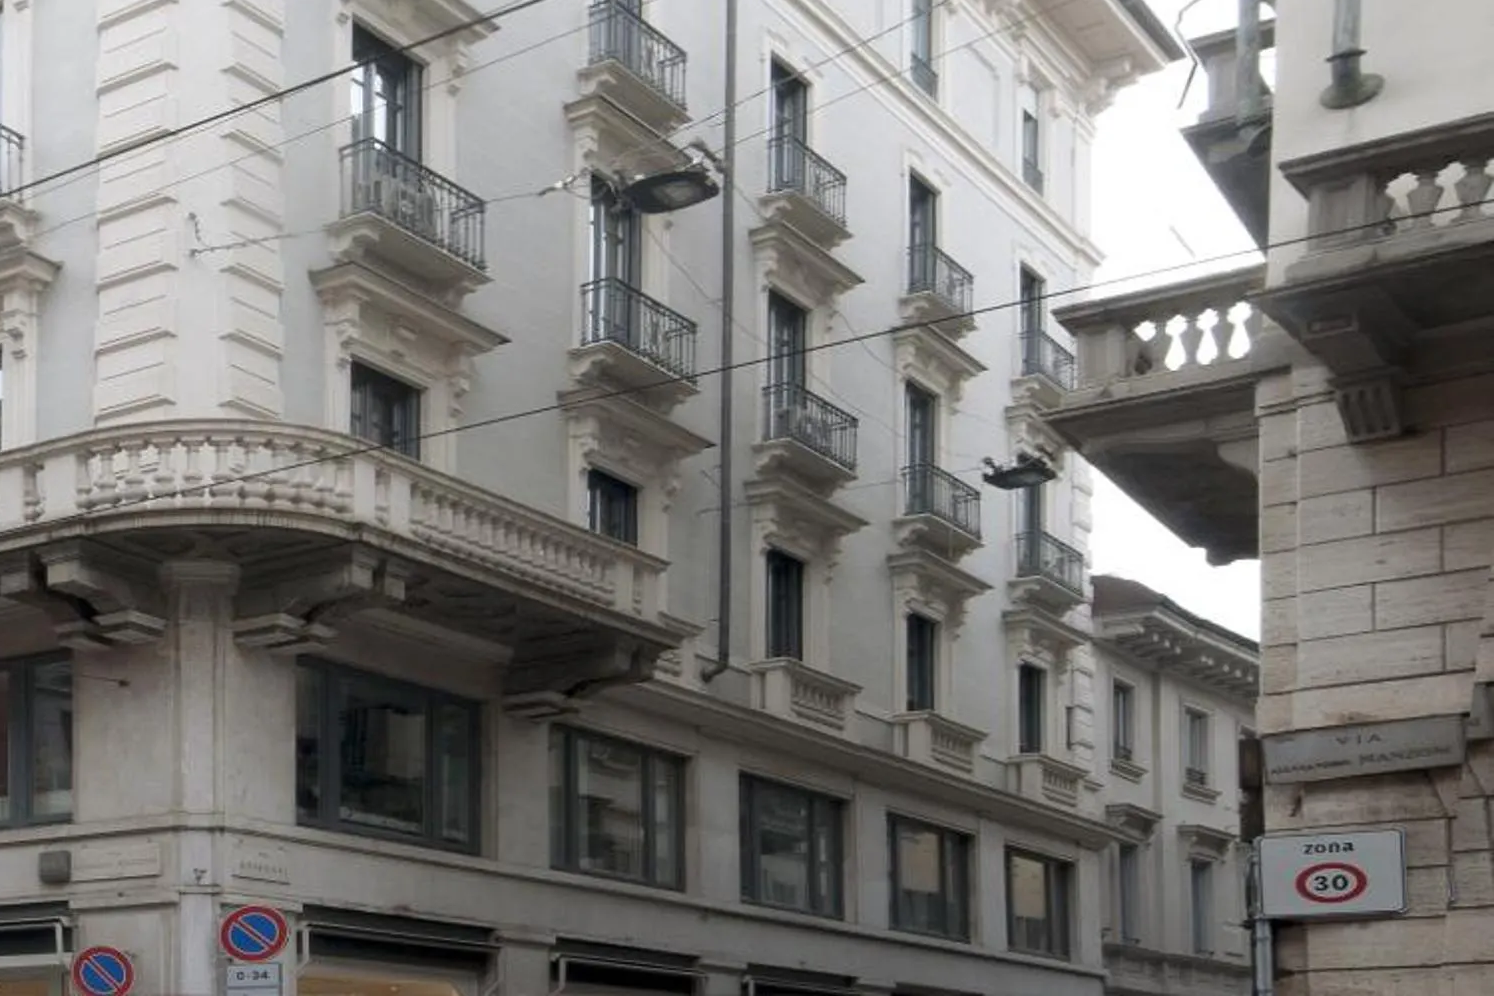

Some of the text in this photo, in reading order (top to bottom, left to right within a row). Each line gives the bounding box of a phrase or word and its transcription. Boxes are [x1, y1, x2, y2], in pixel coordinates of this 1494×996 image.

[1335, 732, 1383, 745] VIA
[1303, 842, 1355, 855] zona
[1313, 875, 1349, 892] 30
